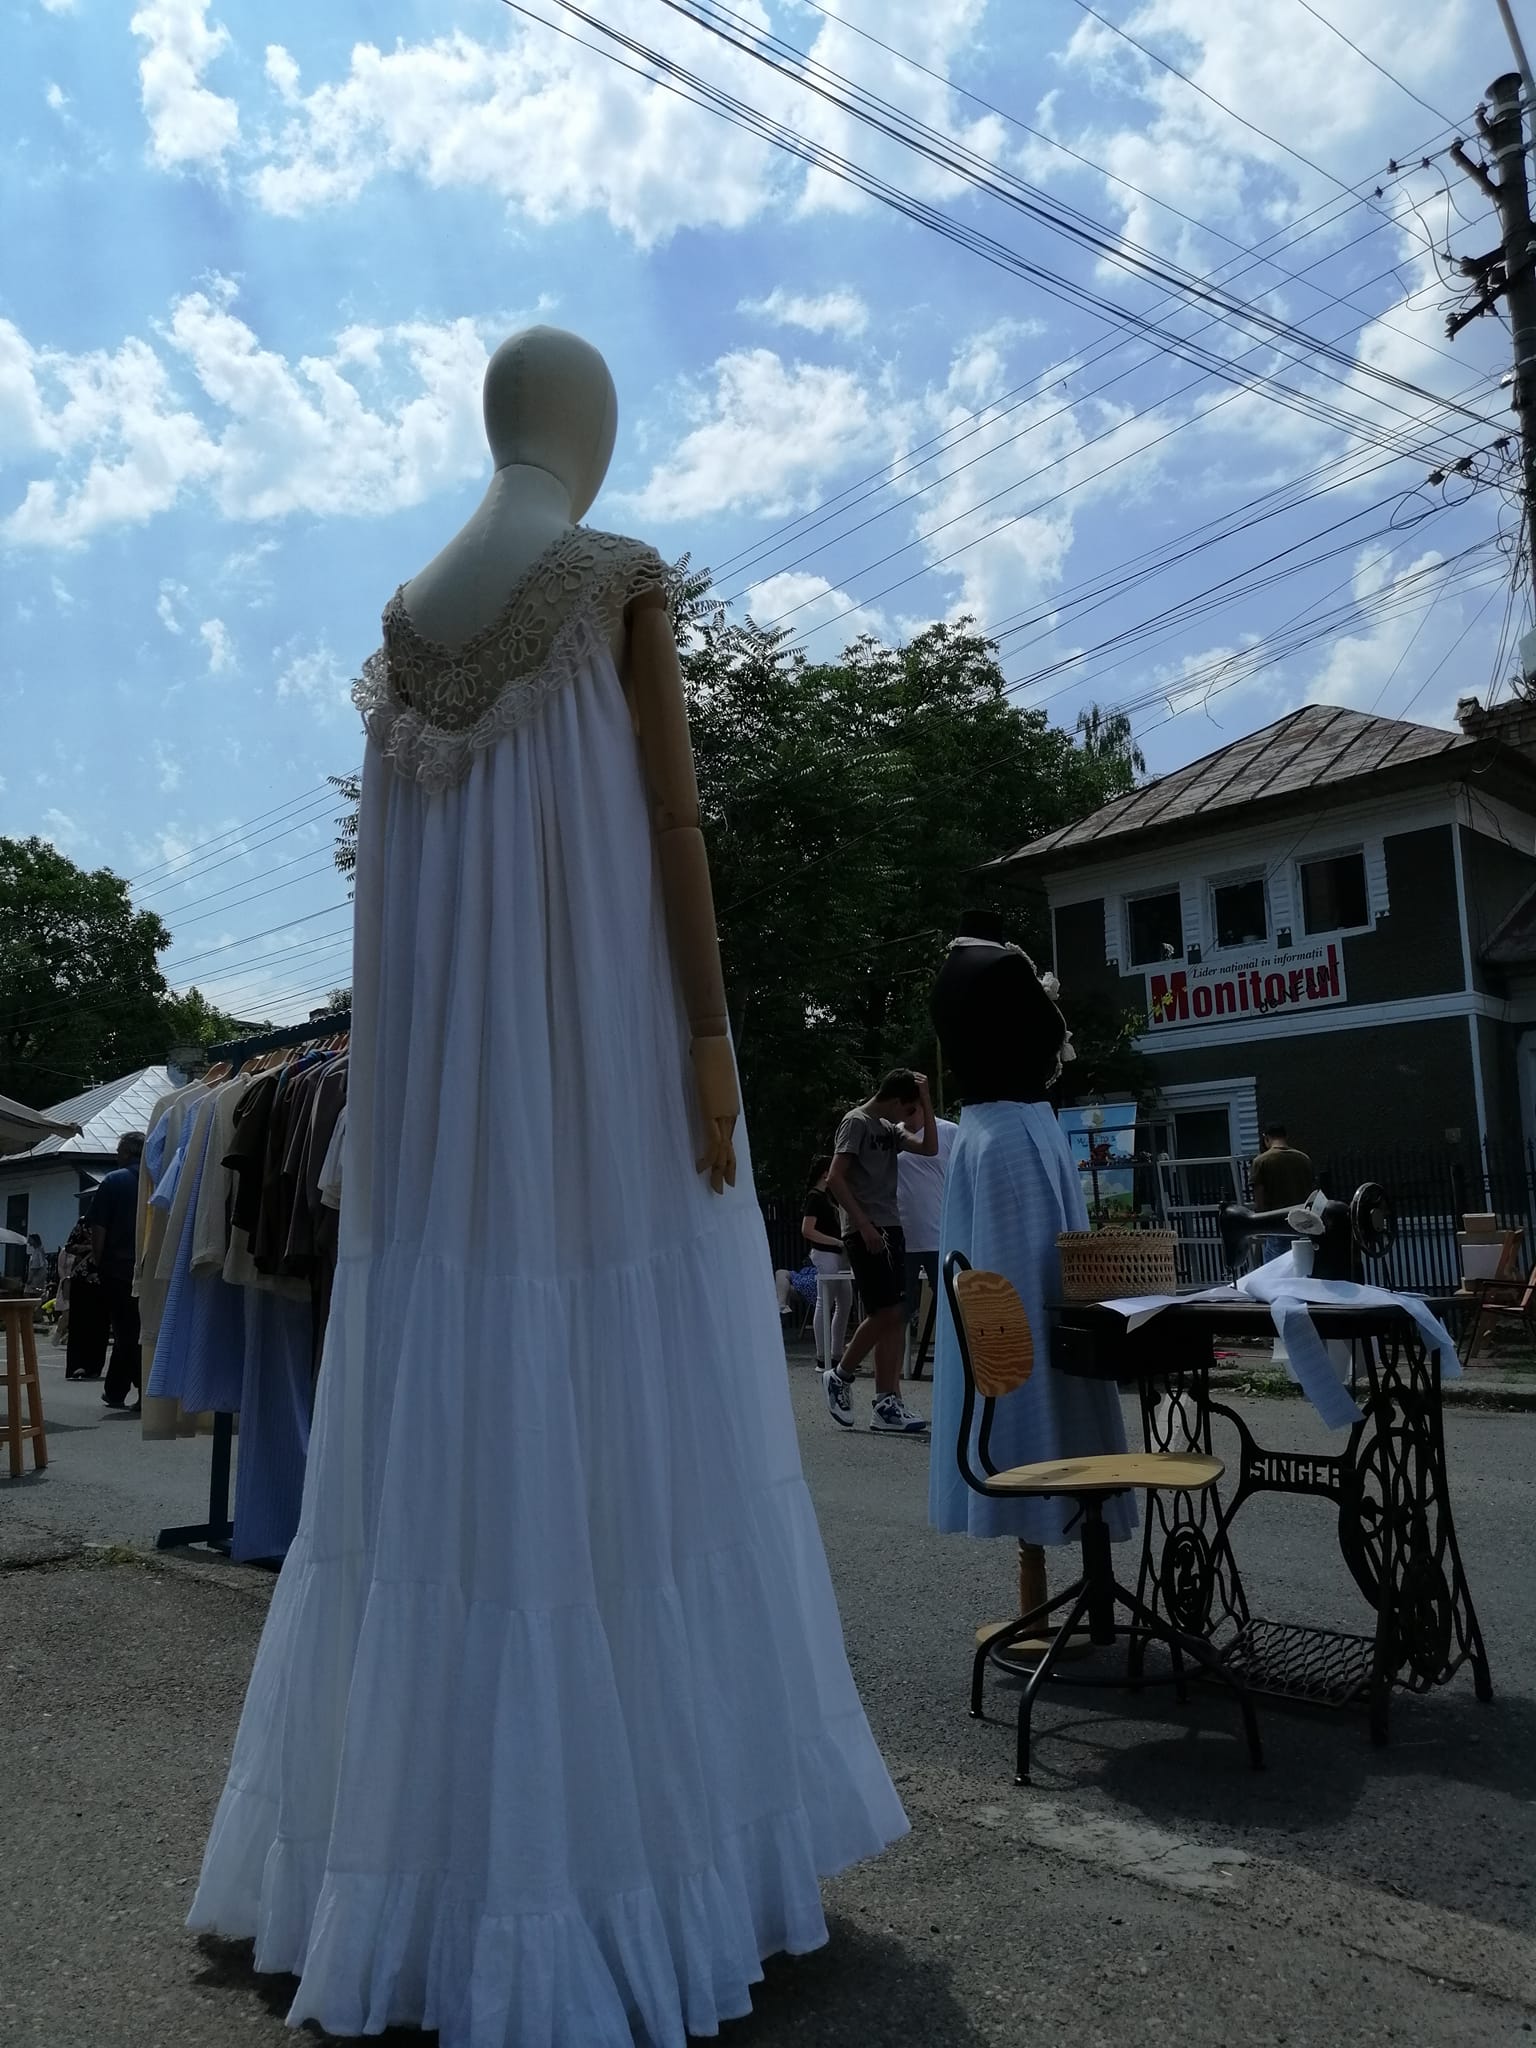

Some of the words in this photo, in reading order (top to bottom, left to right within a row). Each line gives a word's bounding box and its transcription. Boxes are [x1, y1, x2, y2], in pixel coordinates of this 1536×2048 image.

[1192, 966, 1218, 979] Lider
[1150, 944, 1340, 1024] Monitorul
[1260, 998, 1279, 1013] de
[1249, 1458, 1344, 1488] SINGER
